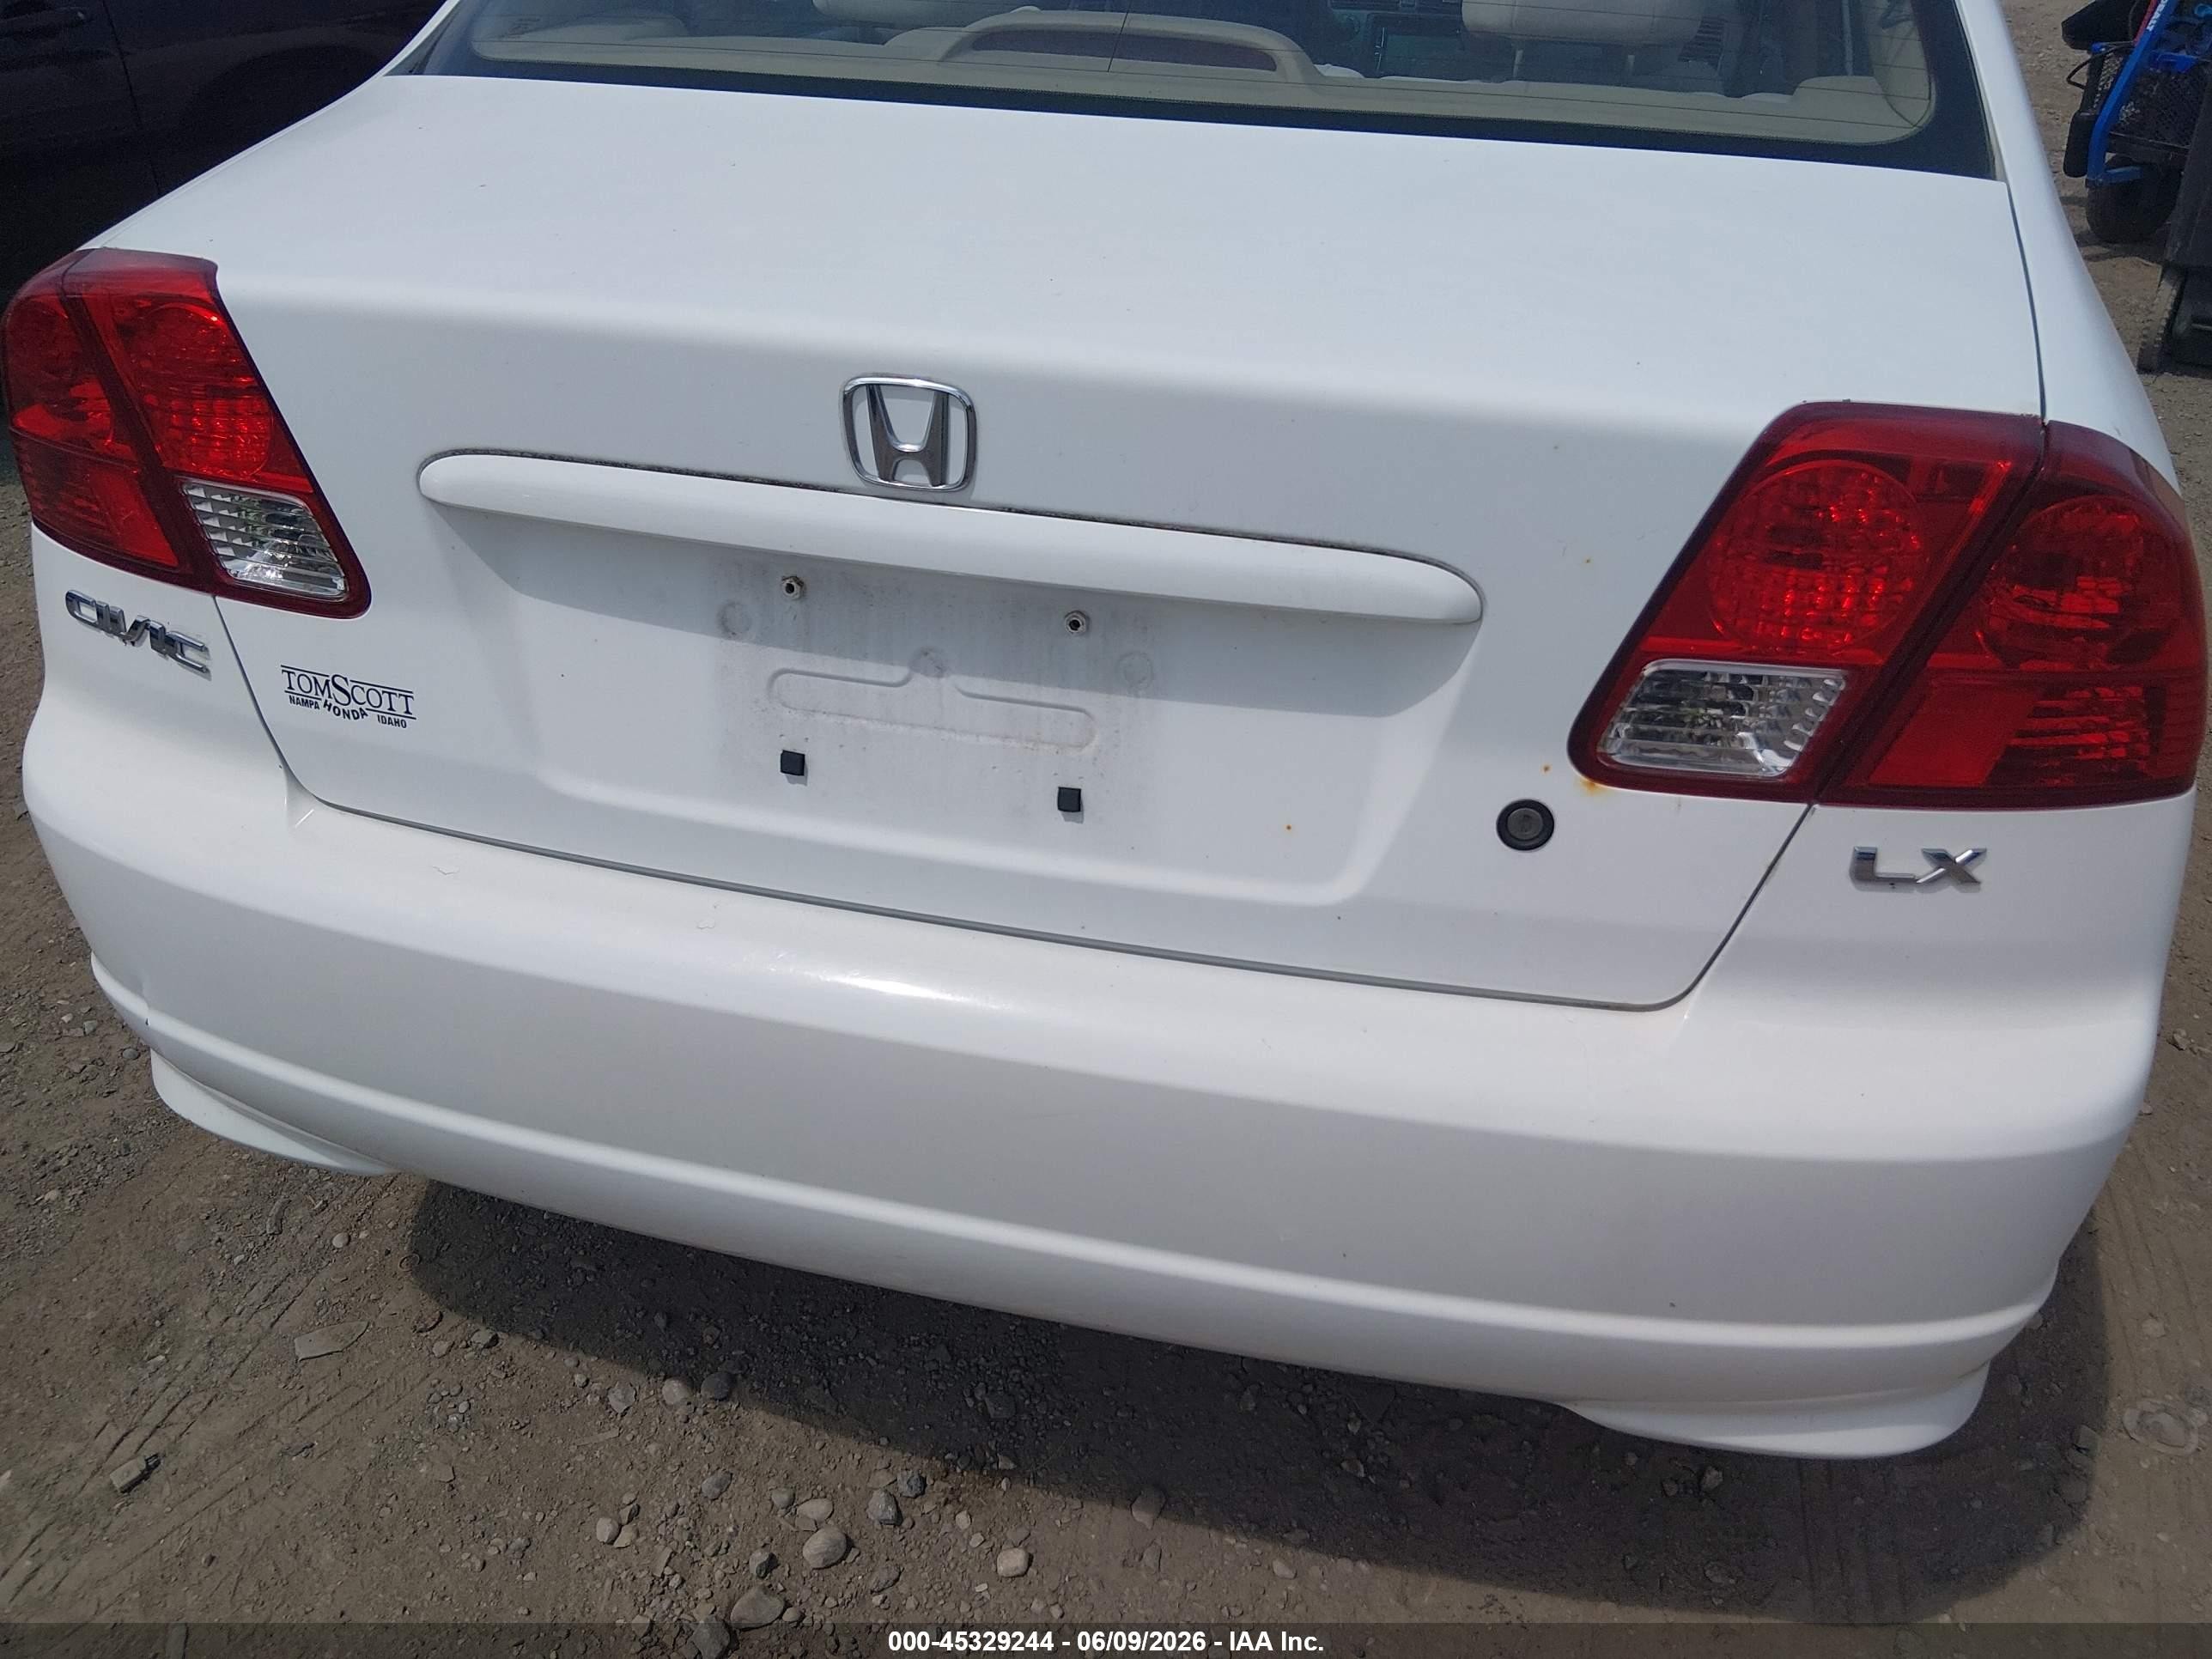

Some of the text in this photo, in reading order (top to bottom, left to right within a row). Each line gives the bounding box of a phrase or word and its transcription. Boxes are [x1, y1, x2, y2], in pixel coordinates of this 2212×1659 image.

[65, 589, 211, 678] CIVIC
[289, 695, 407, 729] NAMPA HONDA IDAHO
[1850, 846, 1988, 886] LX
